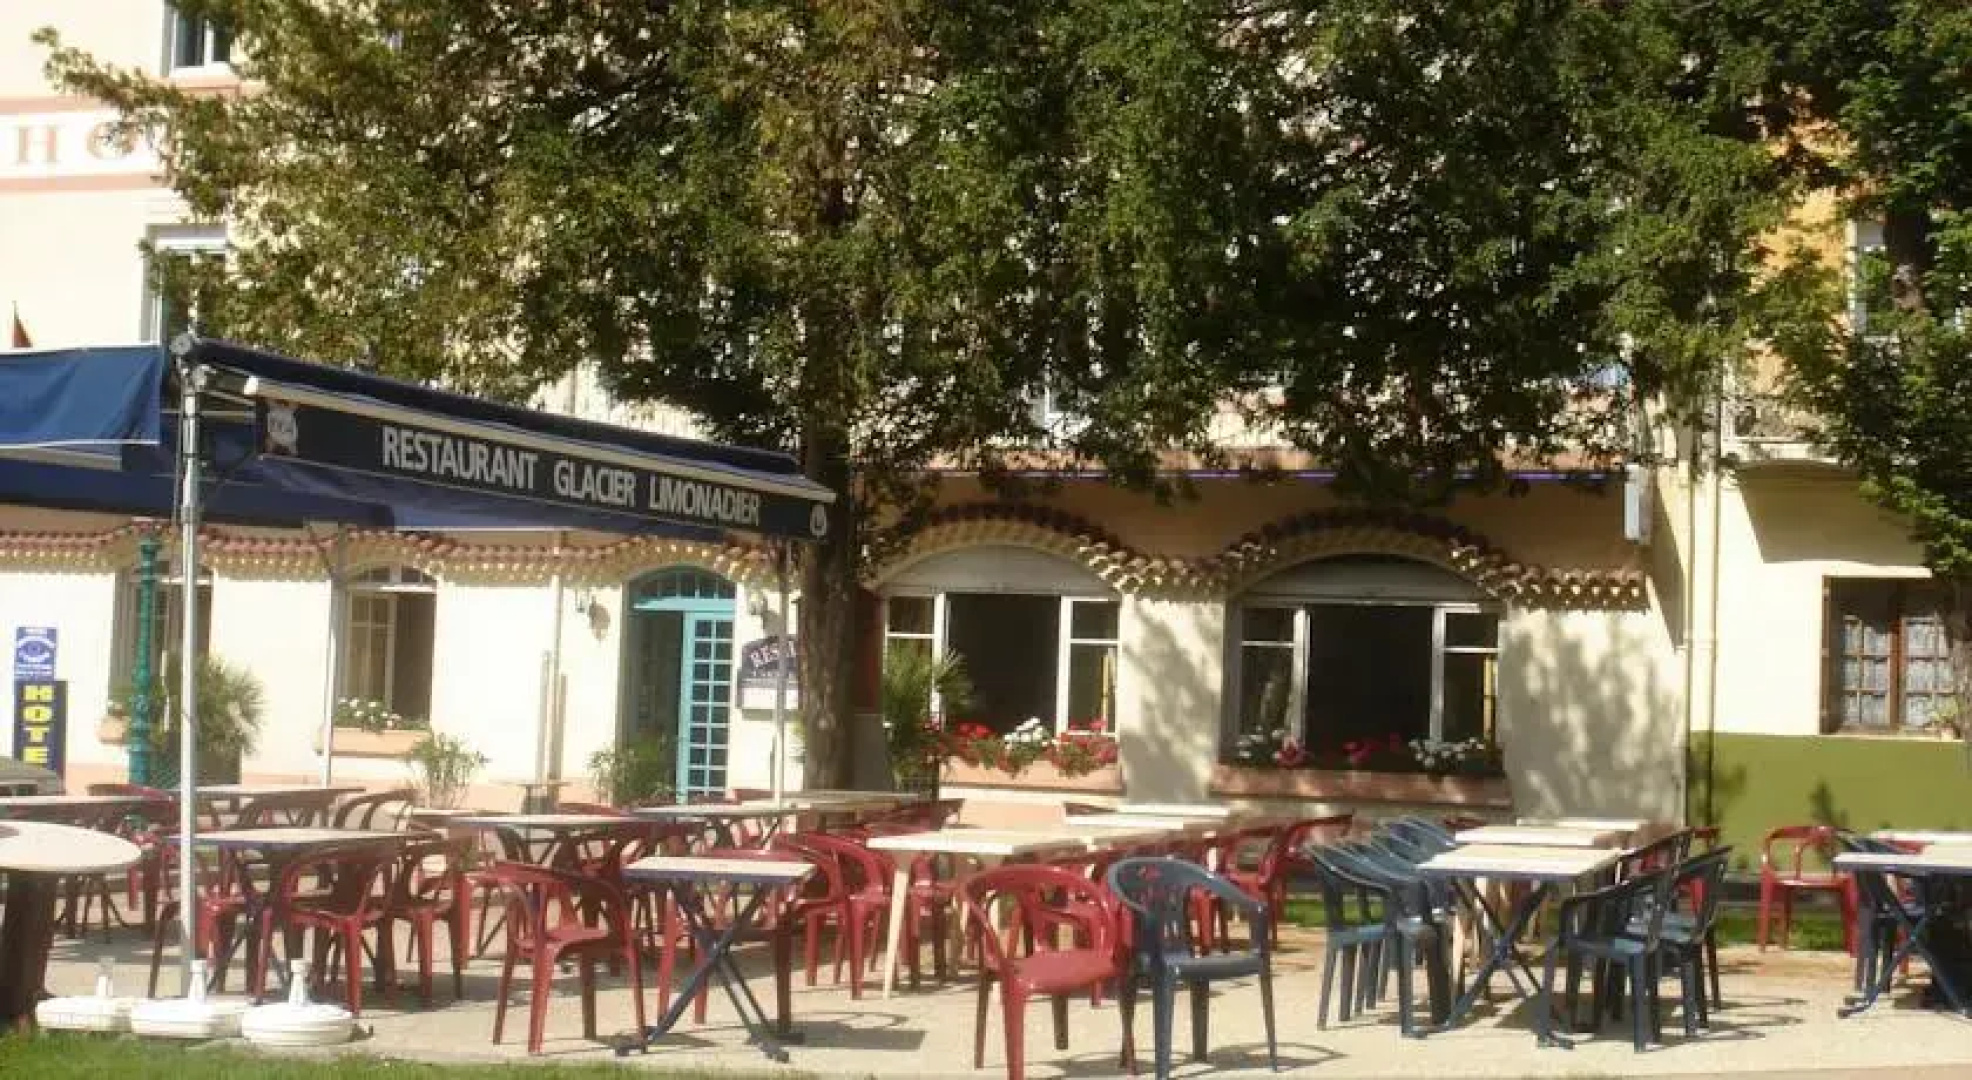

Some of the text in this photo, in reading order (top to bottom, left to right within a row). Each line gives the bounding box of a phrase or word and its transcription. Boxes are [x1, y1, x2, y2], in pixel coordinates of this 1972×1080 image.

[382, 425, 760, 527] RESTAURANT GLACIER LIMONADIER
[23, 684, 54, 764] HOTE
